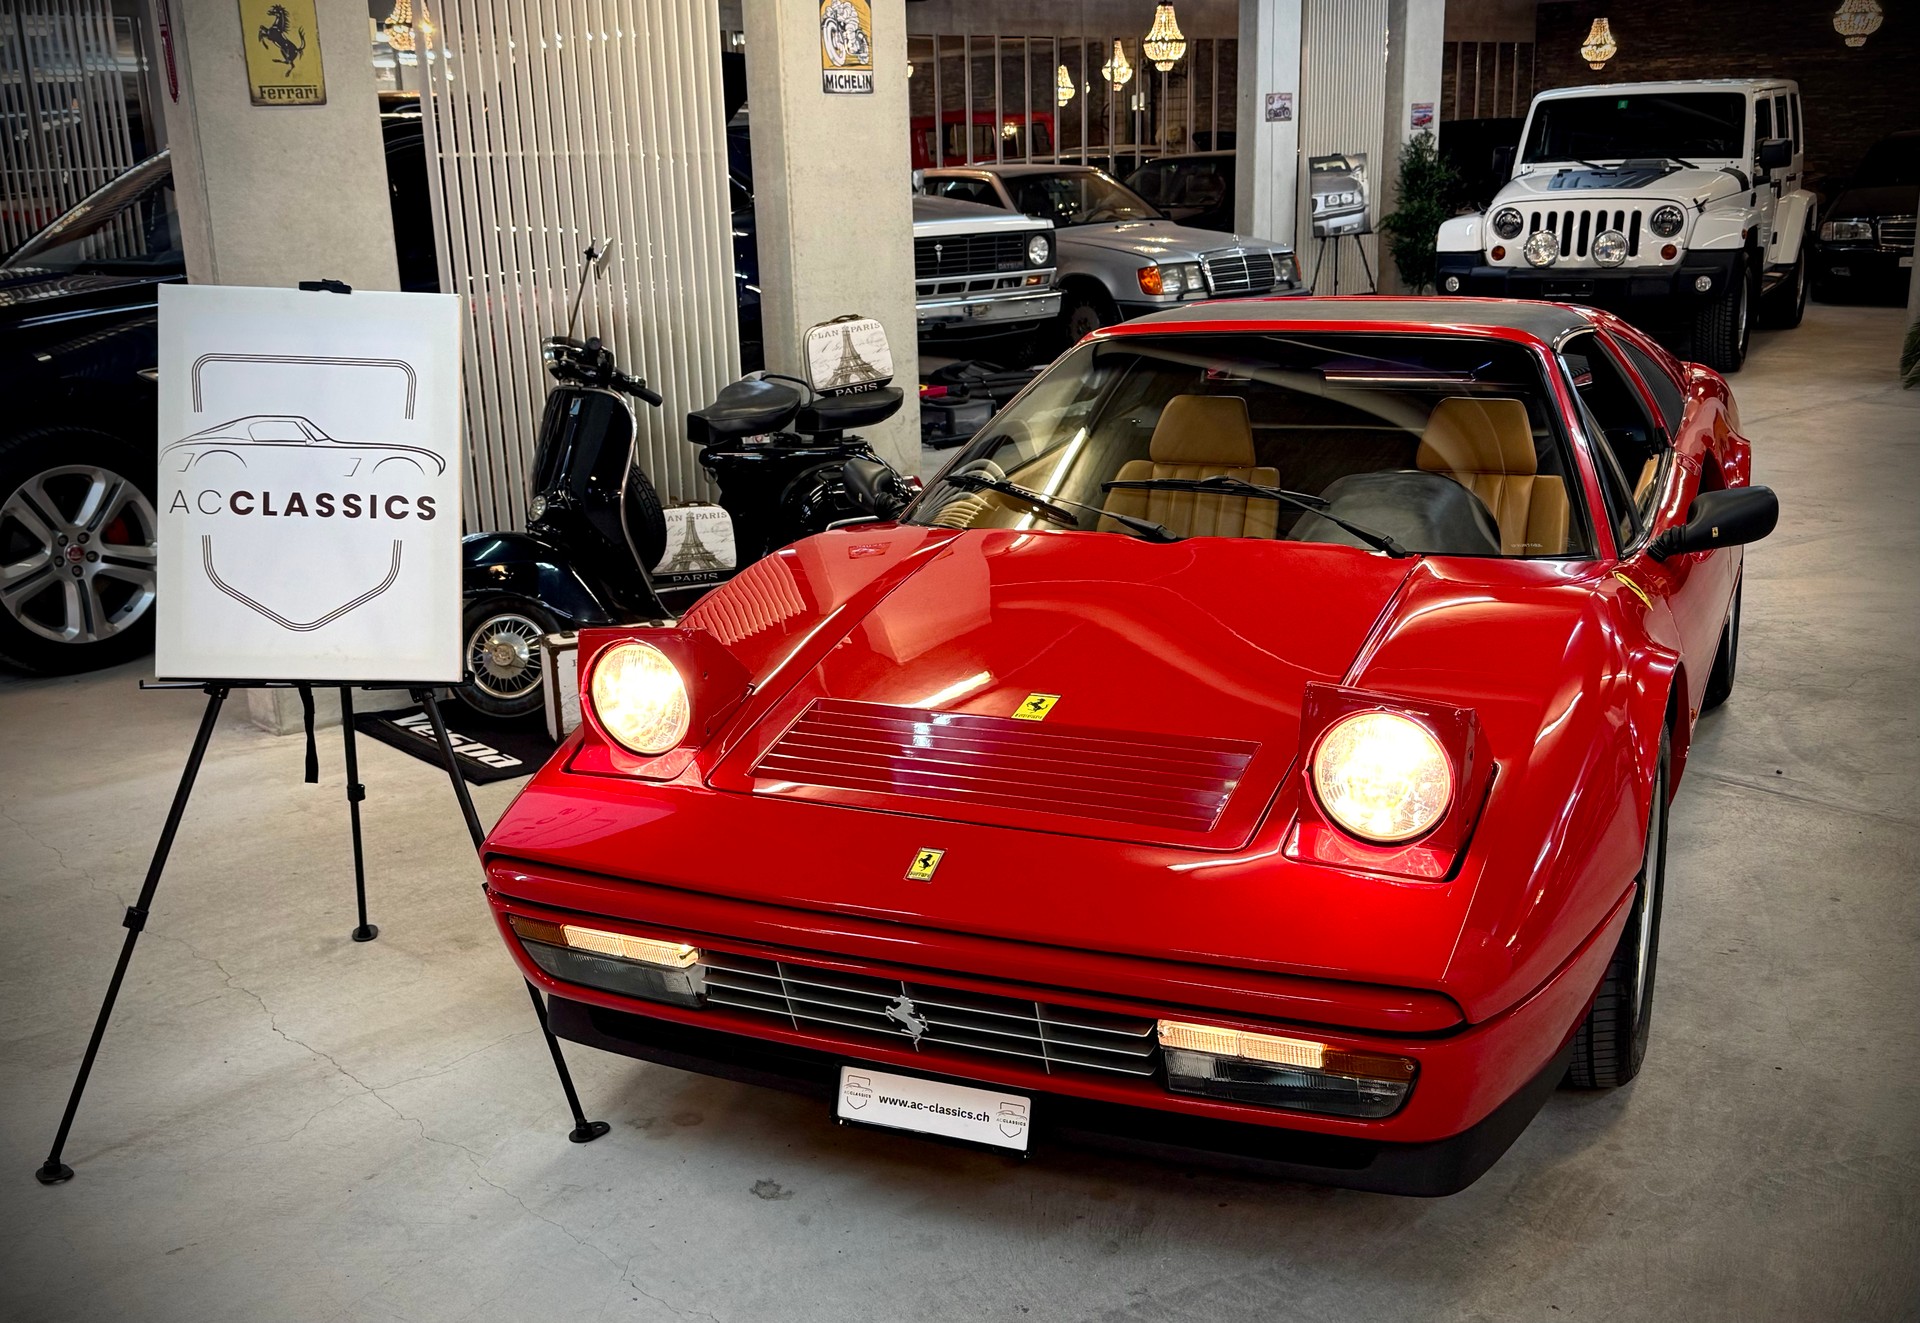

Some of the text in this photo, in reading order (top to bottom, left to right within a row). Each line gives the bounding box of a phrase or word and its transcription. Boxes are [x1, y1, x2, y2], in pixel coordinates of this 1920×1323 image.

[825, 74, 872, 89] MICHELIN
[258, 85, 319, 99] Ferrari
[811, 322, 880, 340] PLAN PARIS
[835, 382, 878, 397] PARIS
[695, 511, 727, 520] PARIS
[672, 572, 718, 582] PARIS
[879, 1094, 990, 1123] www.ac-classics.ch
